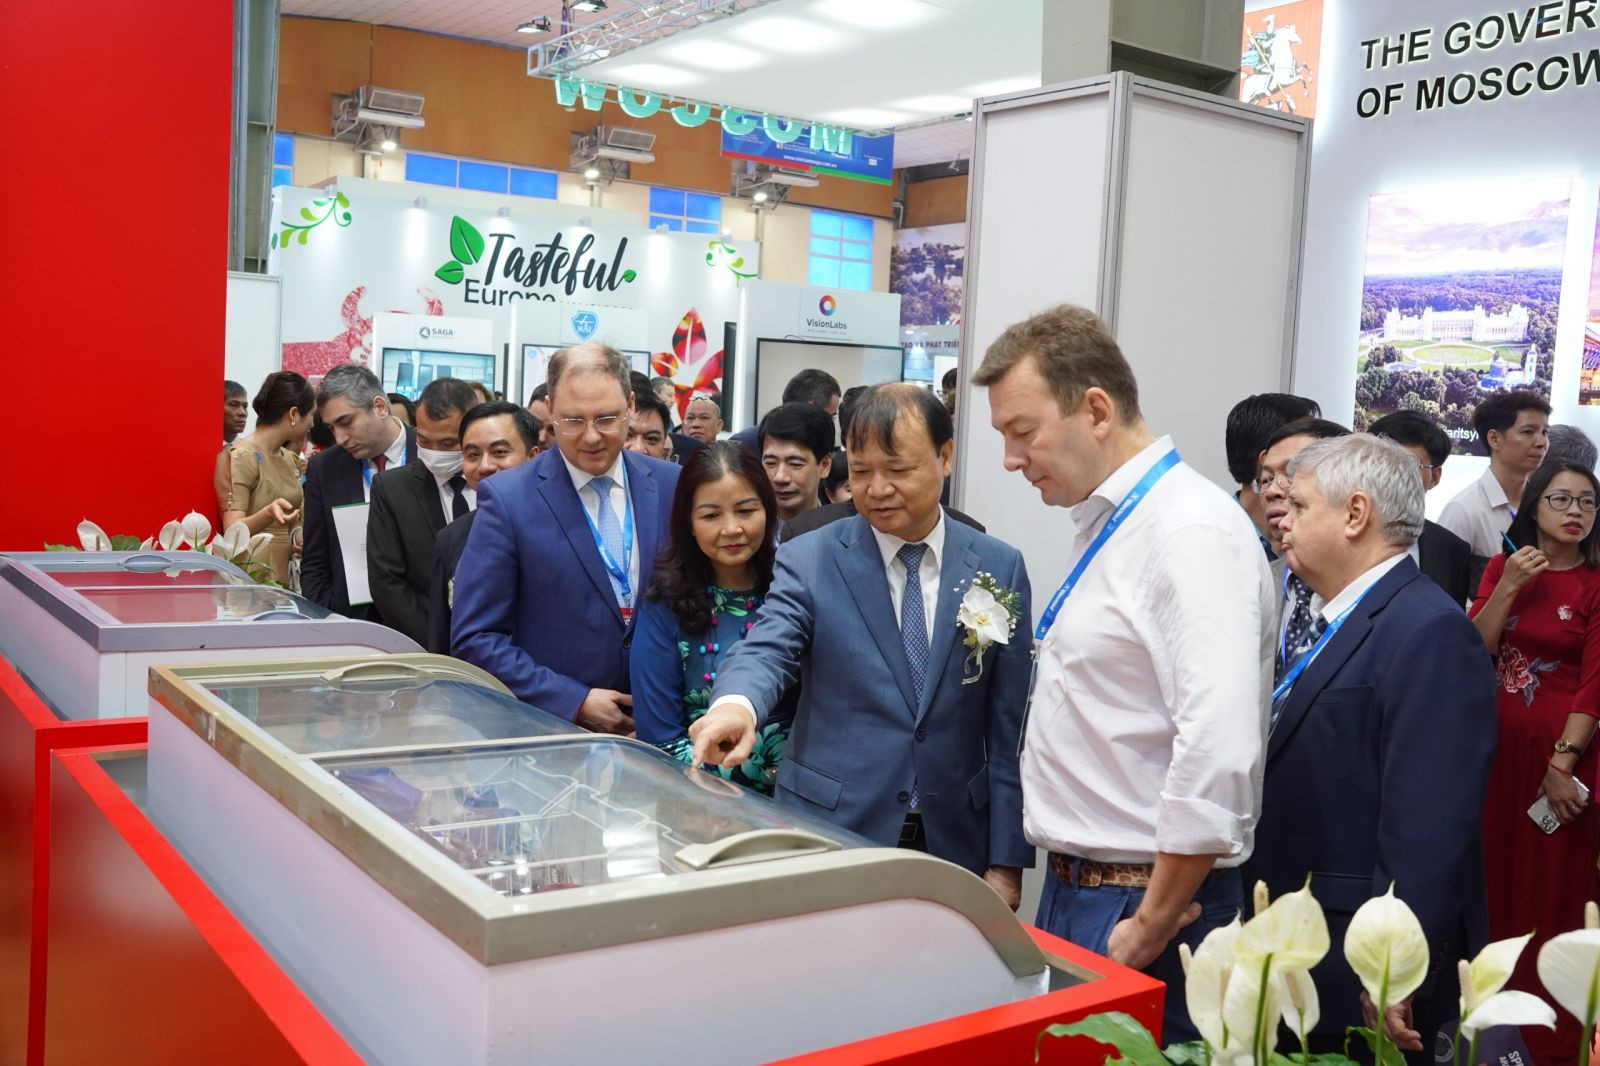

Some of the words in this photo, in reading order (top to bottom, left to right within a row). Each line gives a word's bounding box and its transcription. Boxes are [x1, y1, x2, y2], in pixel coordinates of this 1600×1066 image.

[1361, 28, 1431, 69] THE
[1356, 83, 1404, 118] OF
[1416, 48, 1600, 111] MOSCOW
[484, 232, 629, 296] Tasteful
[806, 318, 848, 330] VisionLabs
